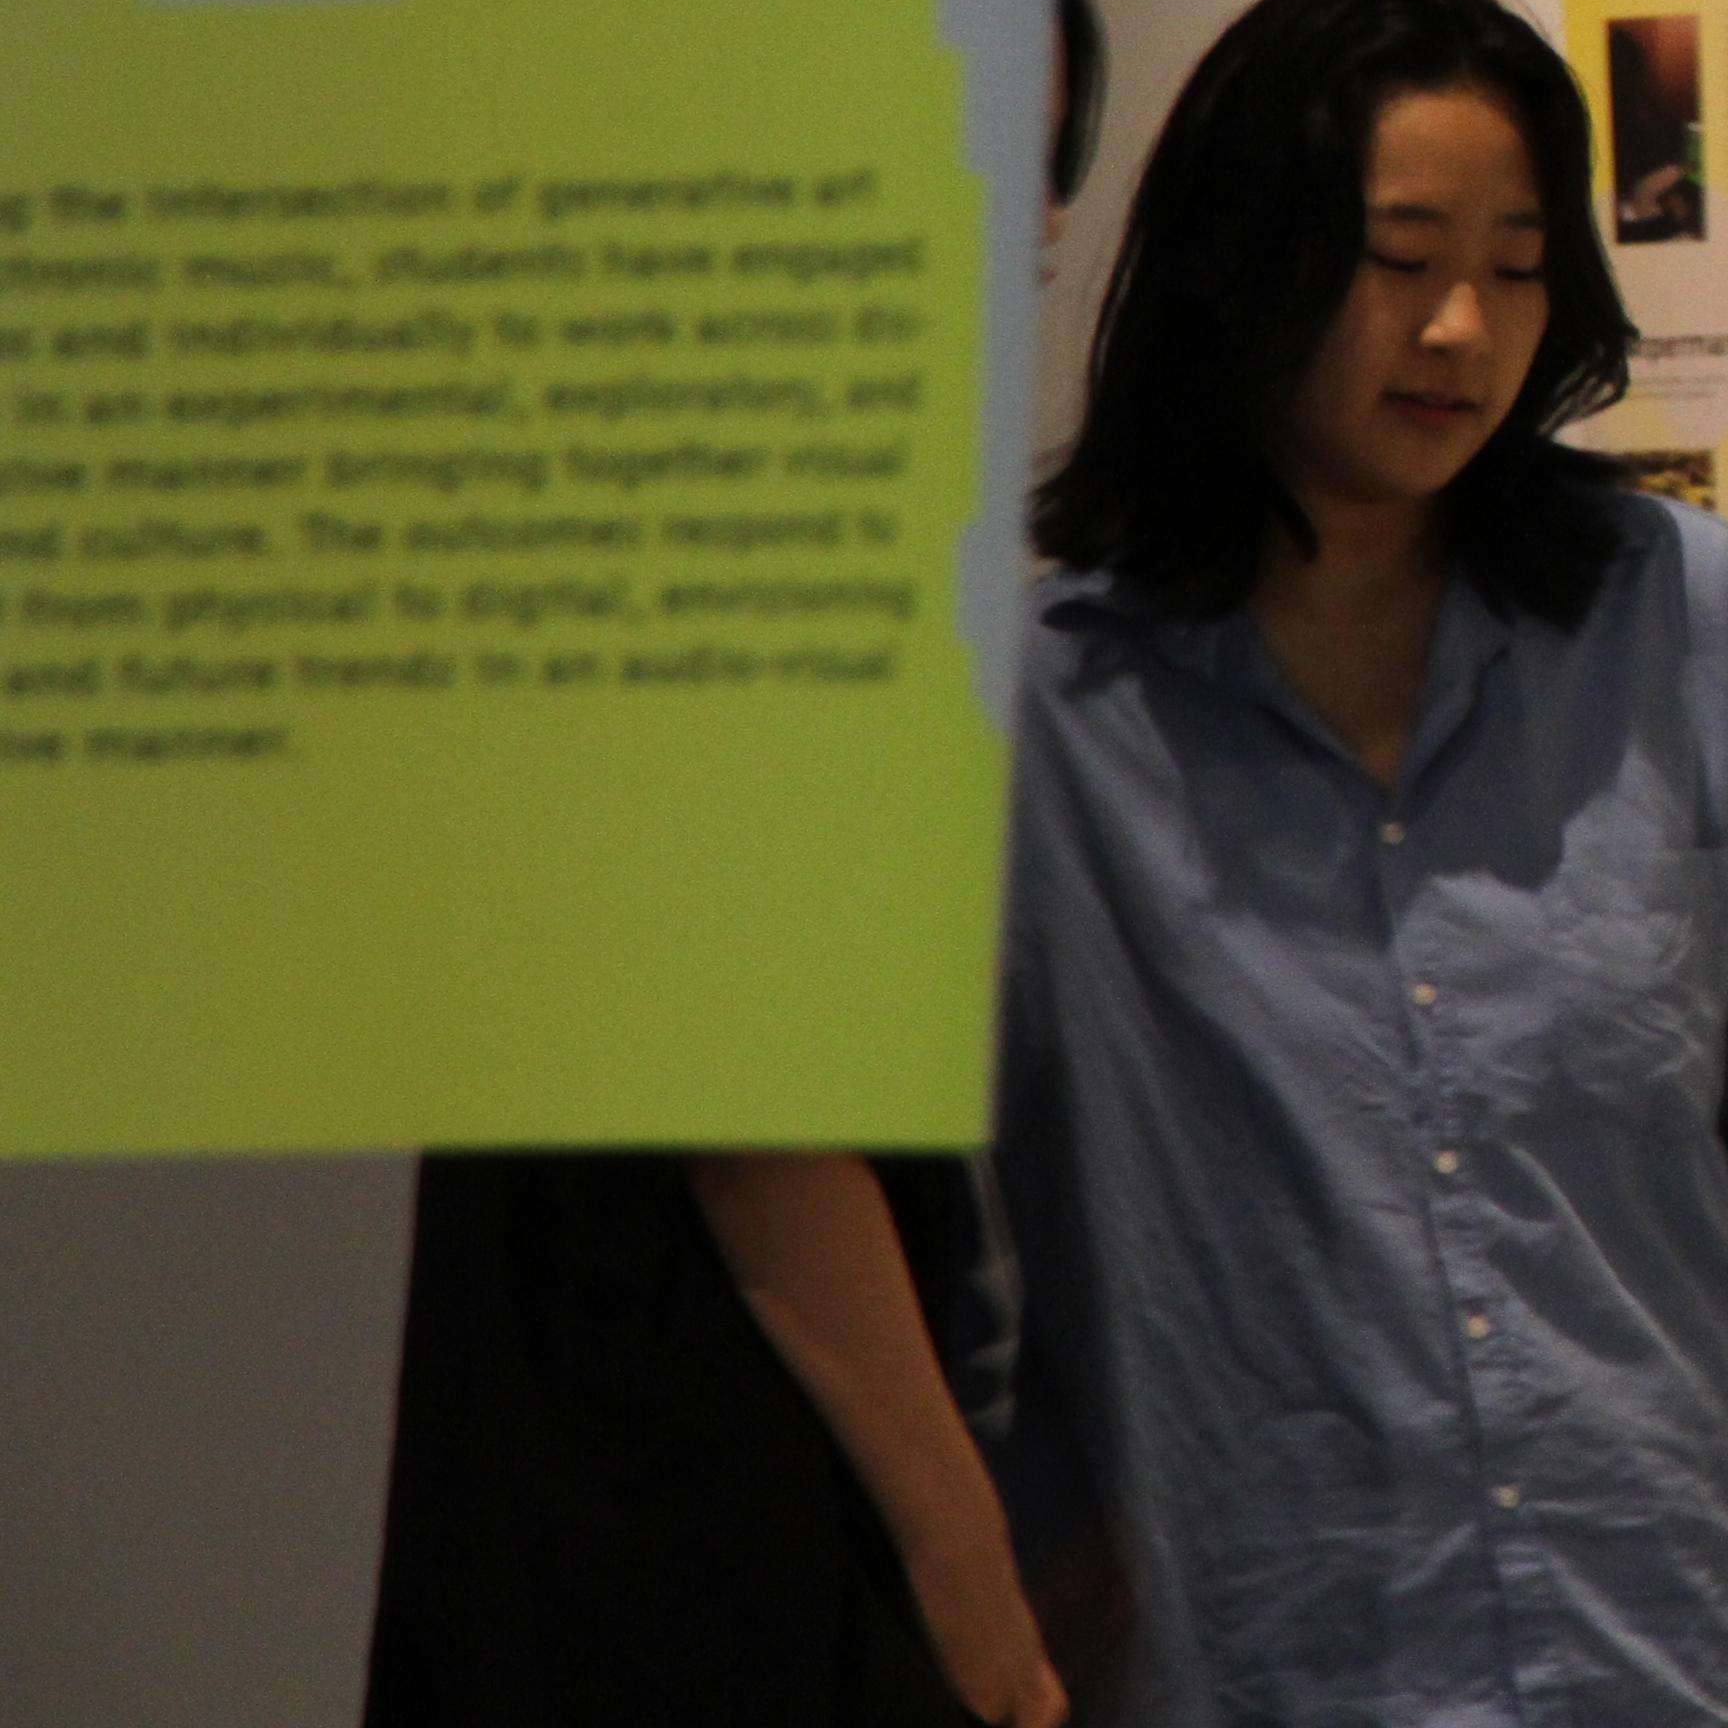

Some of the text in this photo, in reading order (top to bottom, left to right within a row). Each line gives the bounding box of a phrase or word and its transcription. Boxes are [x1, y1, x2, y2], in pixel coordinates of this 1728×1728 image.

[50, 185, 126, 222] the
[145, 180, 452, 219] intersection
[472, 172, 520, 214] of
[538, 172, 794, 222] generative
[812, 170, 874, 207] art
[374, 244, 584, 286] students
[601, 242, 712, 278] have
[732, 238, 921, 284] engaged
[52, 320, 148, 358] and
[166, 307, 474, 358] individually
[493, 312, 537, 346] to
[561, 309, 673, 346] work
[697, 309, 838, 346] across
[84, 390, 142, 423] an
[847, 370, 919, 413] and
[104, 456, 306, 491] manner
[325, 449, 546, 494] bringing
[564, 443, 768, 492] together
[783, 444, 904, 478] visual
[300, 510, 384, 554] The
[402, 510, 640, 554] outcomes
[660, 510, 842, 554] respond
[858, 506, 900, 546] to
[22, 584, 146, 628] from
[164, 576, 378, 632] physical
[393, 578, 442, 622] to
[6, 660, 100, 696] and
[116, 652, 276, 694] future
[295, 652, 456, 689] trends
[541, 650, 602, 686] an
